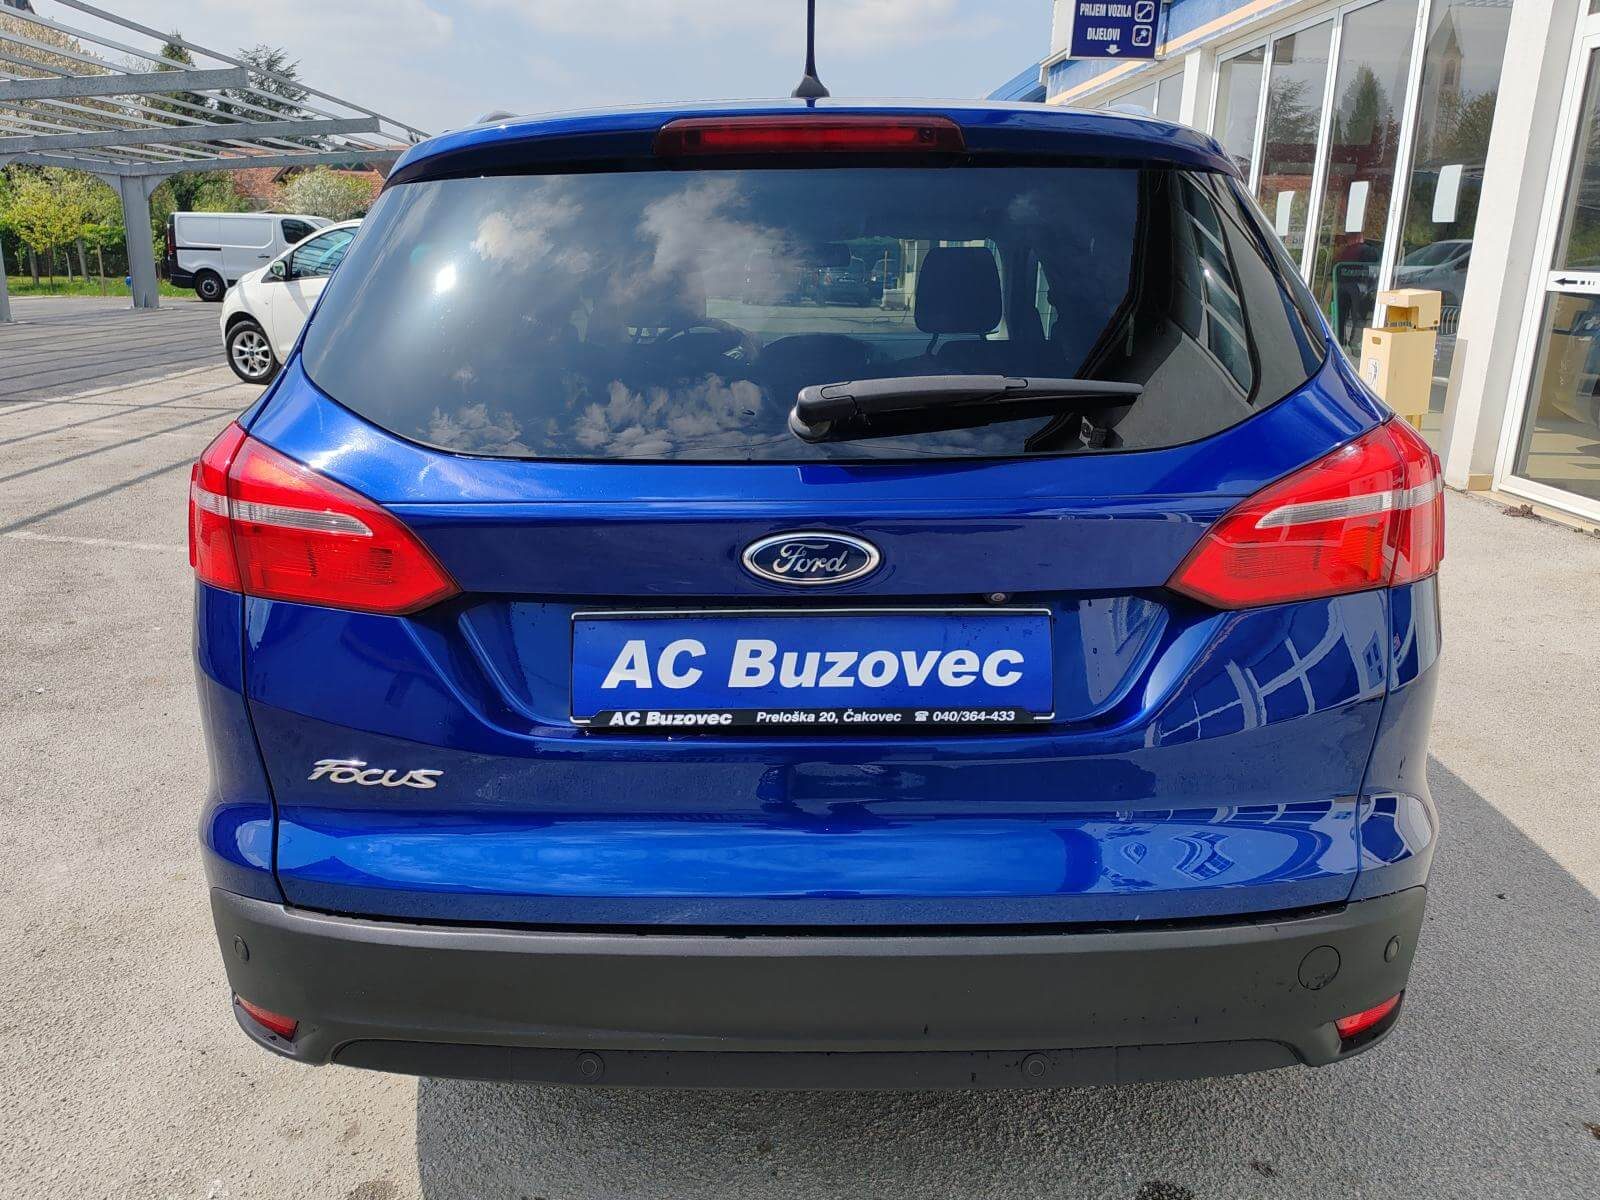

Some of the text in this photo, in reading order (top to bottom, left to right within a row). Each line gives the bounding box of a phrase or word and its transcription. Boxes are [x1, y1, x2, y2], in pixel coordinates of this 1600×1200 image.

[1080, 3, 1131, 17] PRIJEM VOZILA
[1087, 28, 1120, 41] DIJELOVI
[772, 543, 848, 574] Ford
[601, 639, 1025, 690] AC Buzovec
[609, 708, 1016, 726] AC Buzovec Preloška 20, Čakovec 040/364-433
